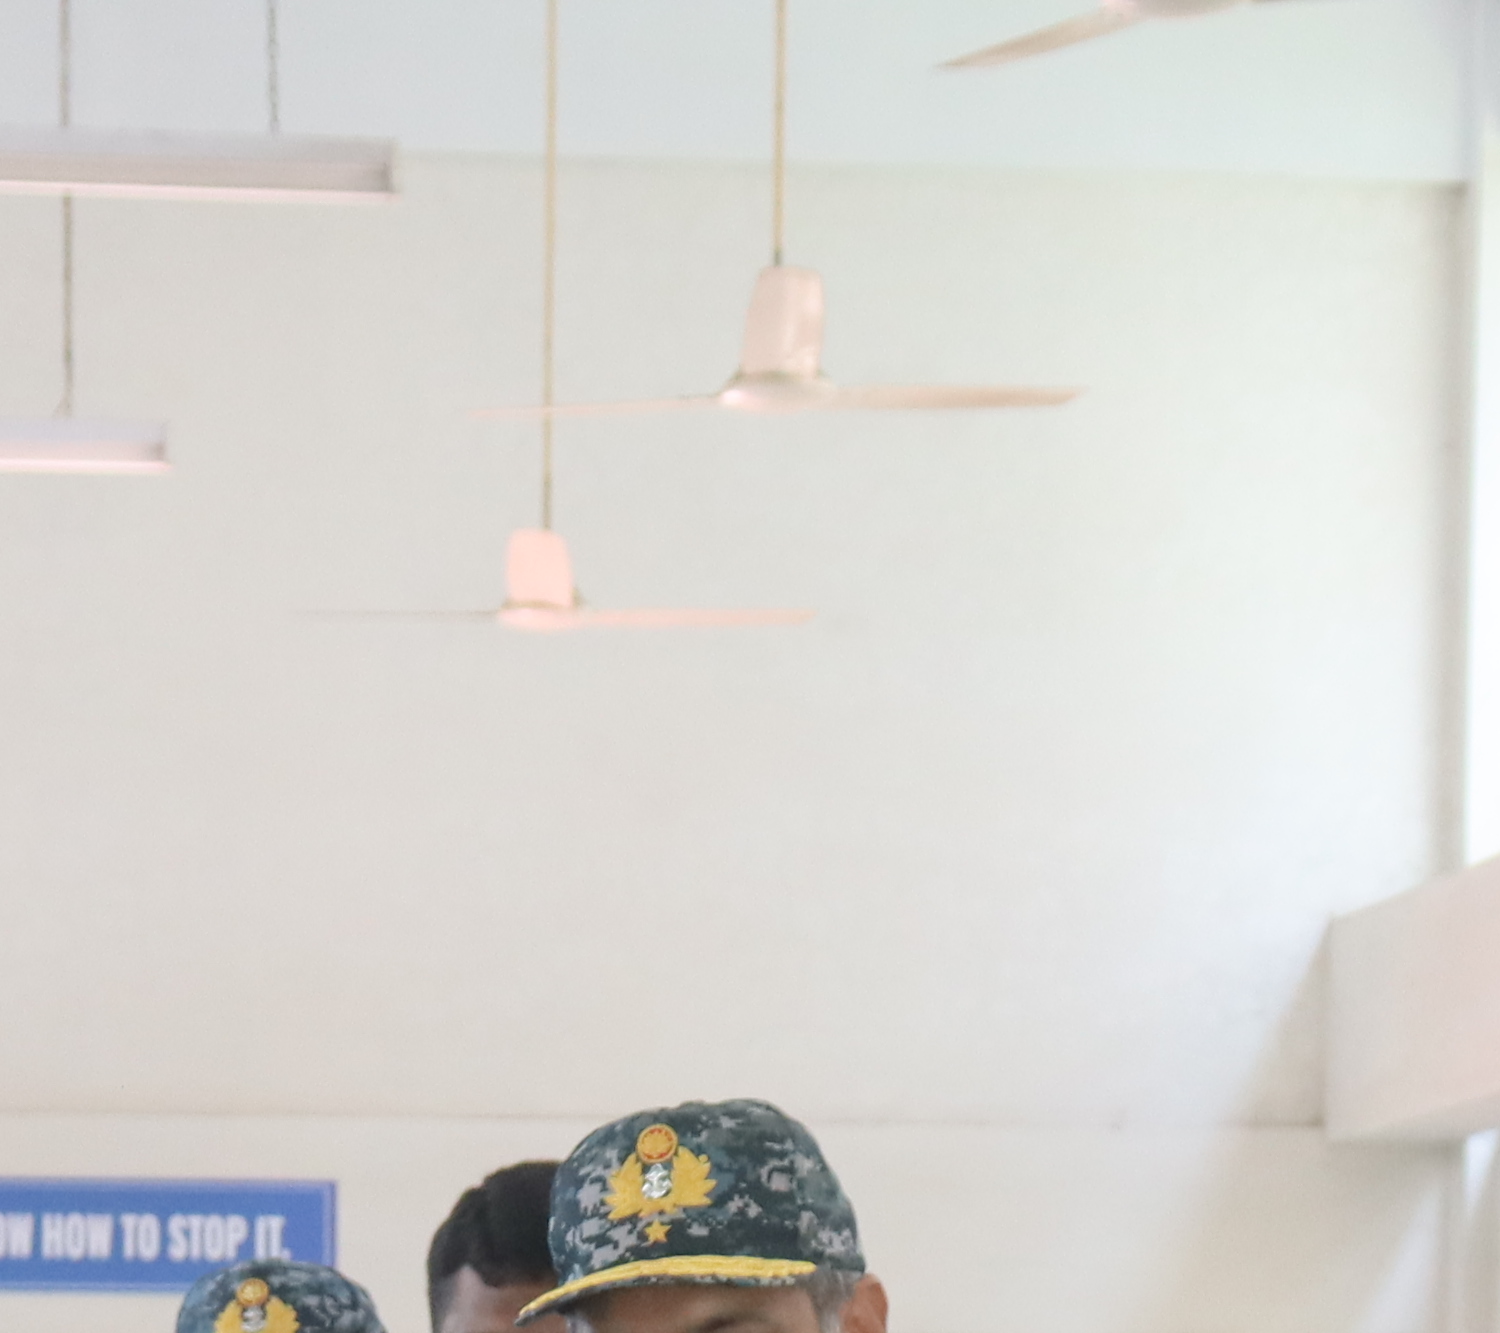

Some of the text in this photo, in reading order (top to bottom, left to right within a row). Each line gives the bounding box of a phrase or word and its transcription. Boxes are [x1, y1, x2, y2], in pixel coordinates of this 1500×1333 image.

[41, 1213, 113, 1260] HOW
[120, 1213, 161, 1261] TO
[167, 1214, 248, 1262] STOP
